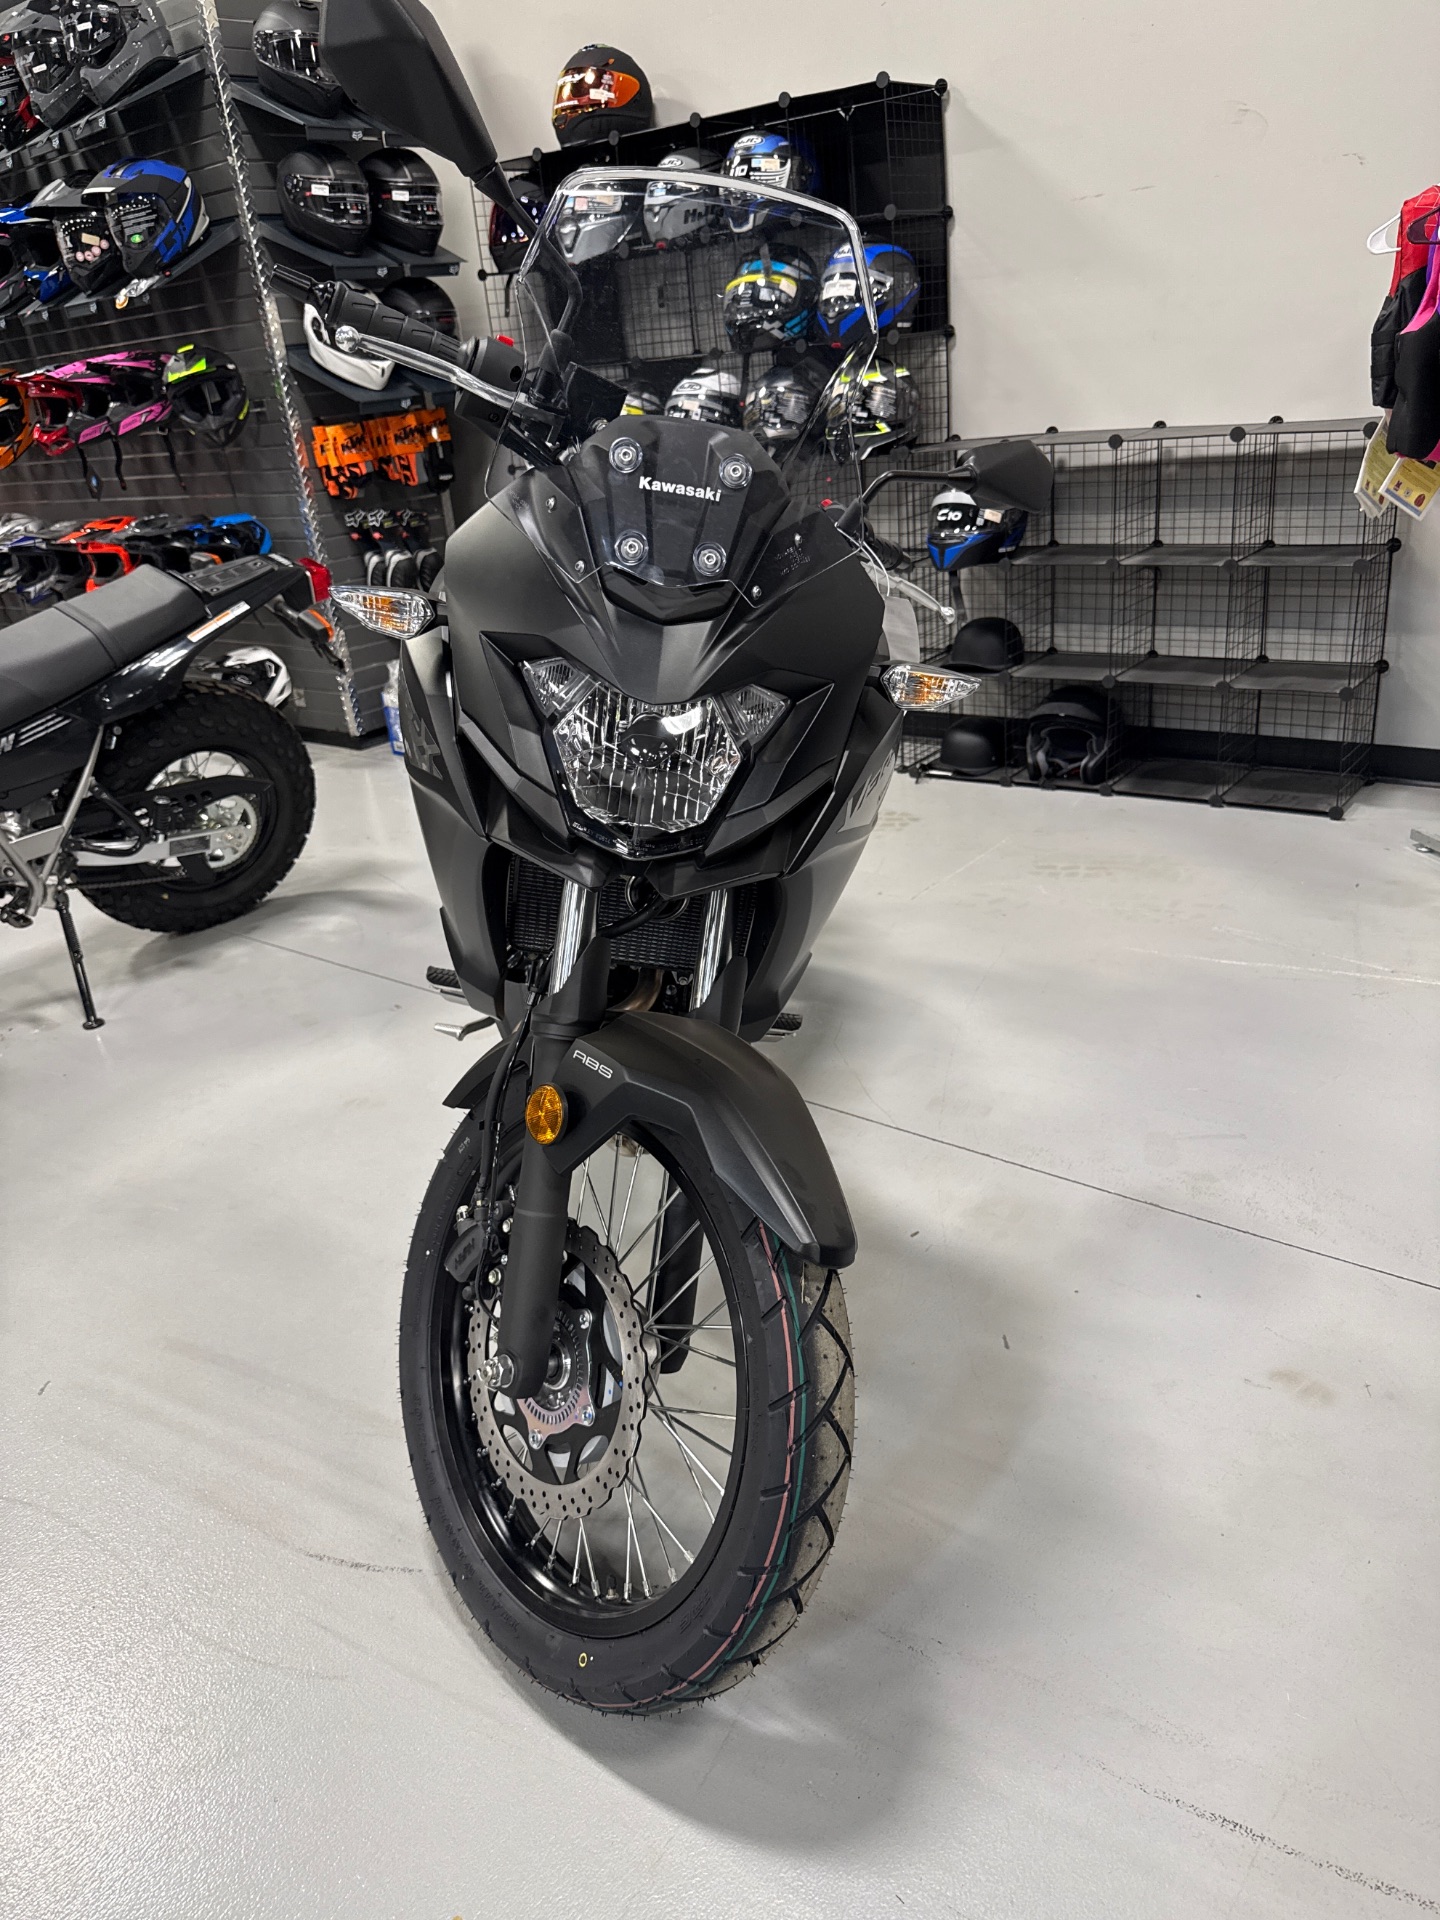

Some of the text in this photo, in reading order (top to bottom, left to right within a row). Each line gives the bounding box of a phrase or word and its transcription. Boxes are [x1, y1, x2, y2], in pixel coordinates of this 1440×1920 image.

[638, 476, 722, 502] Kawasaki
[937, 508, 962, 521] C10
[573, 1049, 613, 1079] ABS
